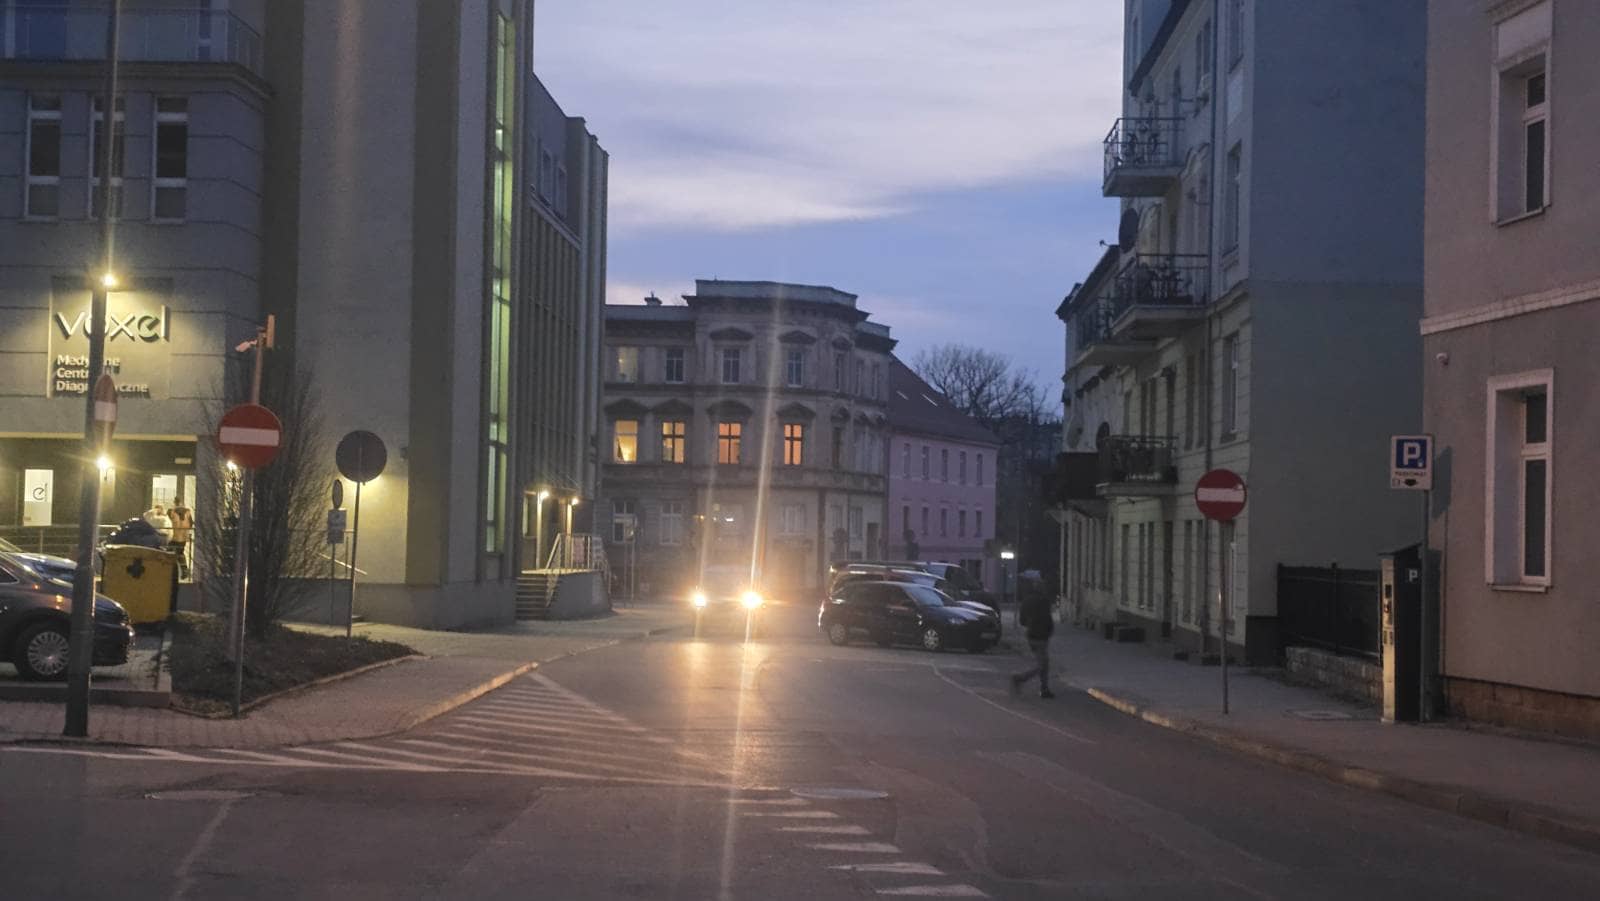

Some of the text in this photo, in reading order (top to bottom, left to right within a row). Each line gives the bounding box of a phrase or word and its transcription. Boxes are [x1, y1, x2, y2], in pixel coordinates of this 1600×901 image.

[57, 354, 120, 368] Medyne
[56, 380, 149, 394] Diagczne
[1403, 442, 1420, 466] P
[1408, 569, 1418, 582] P
